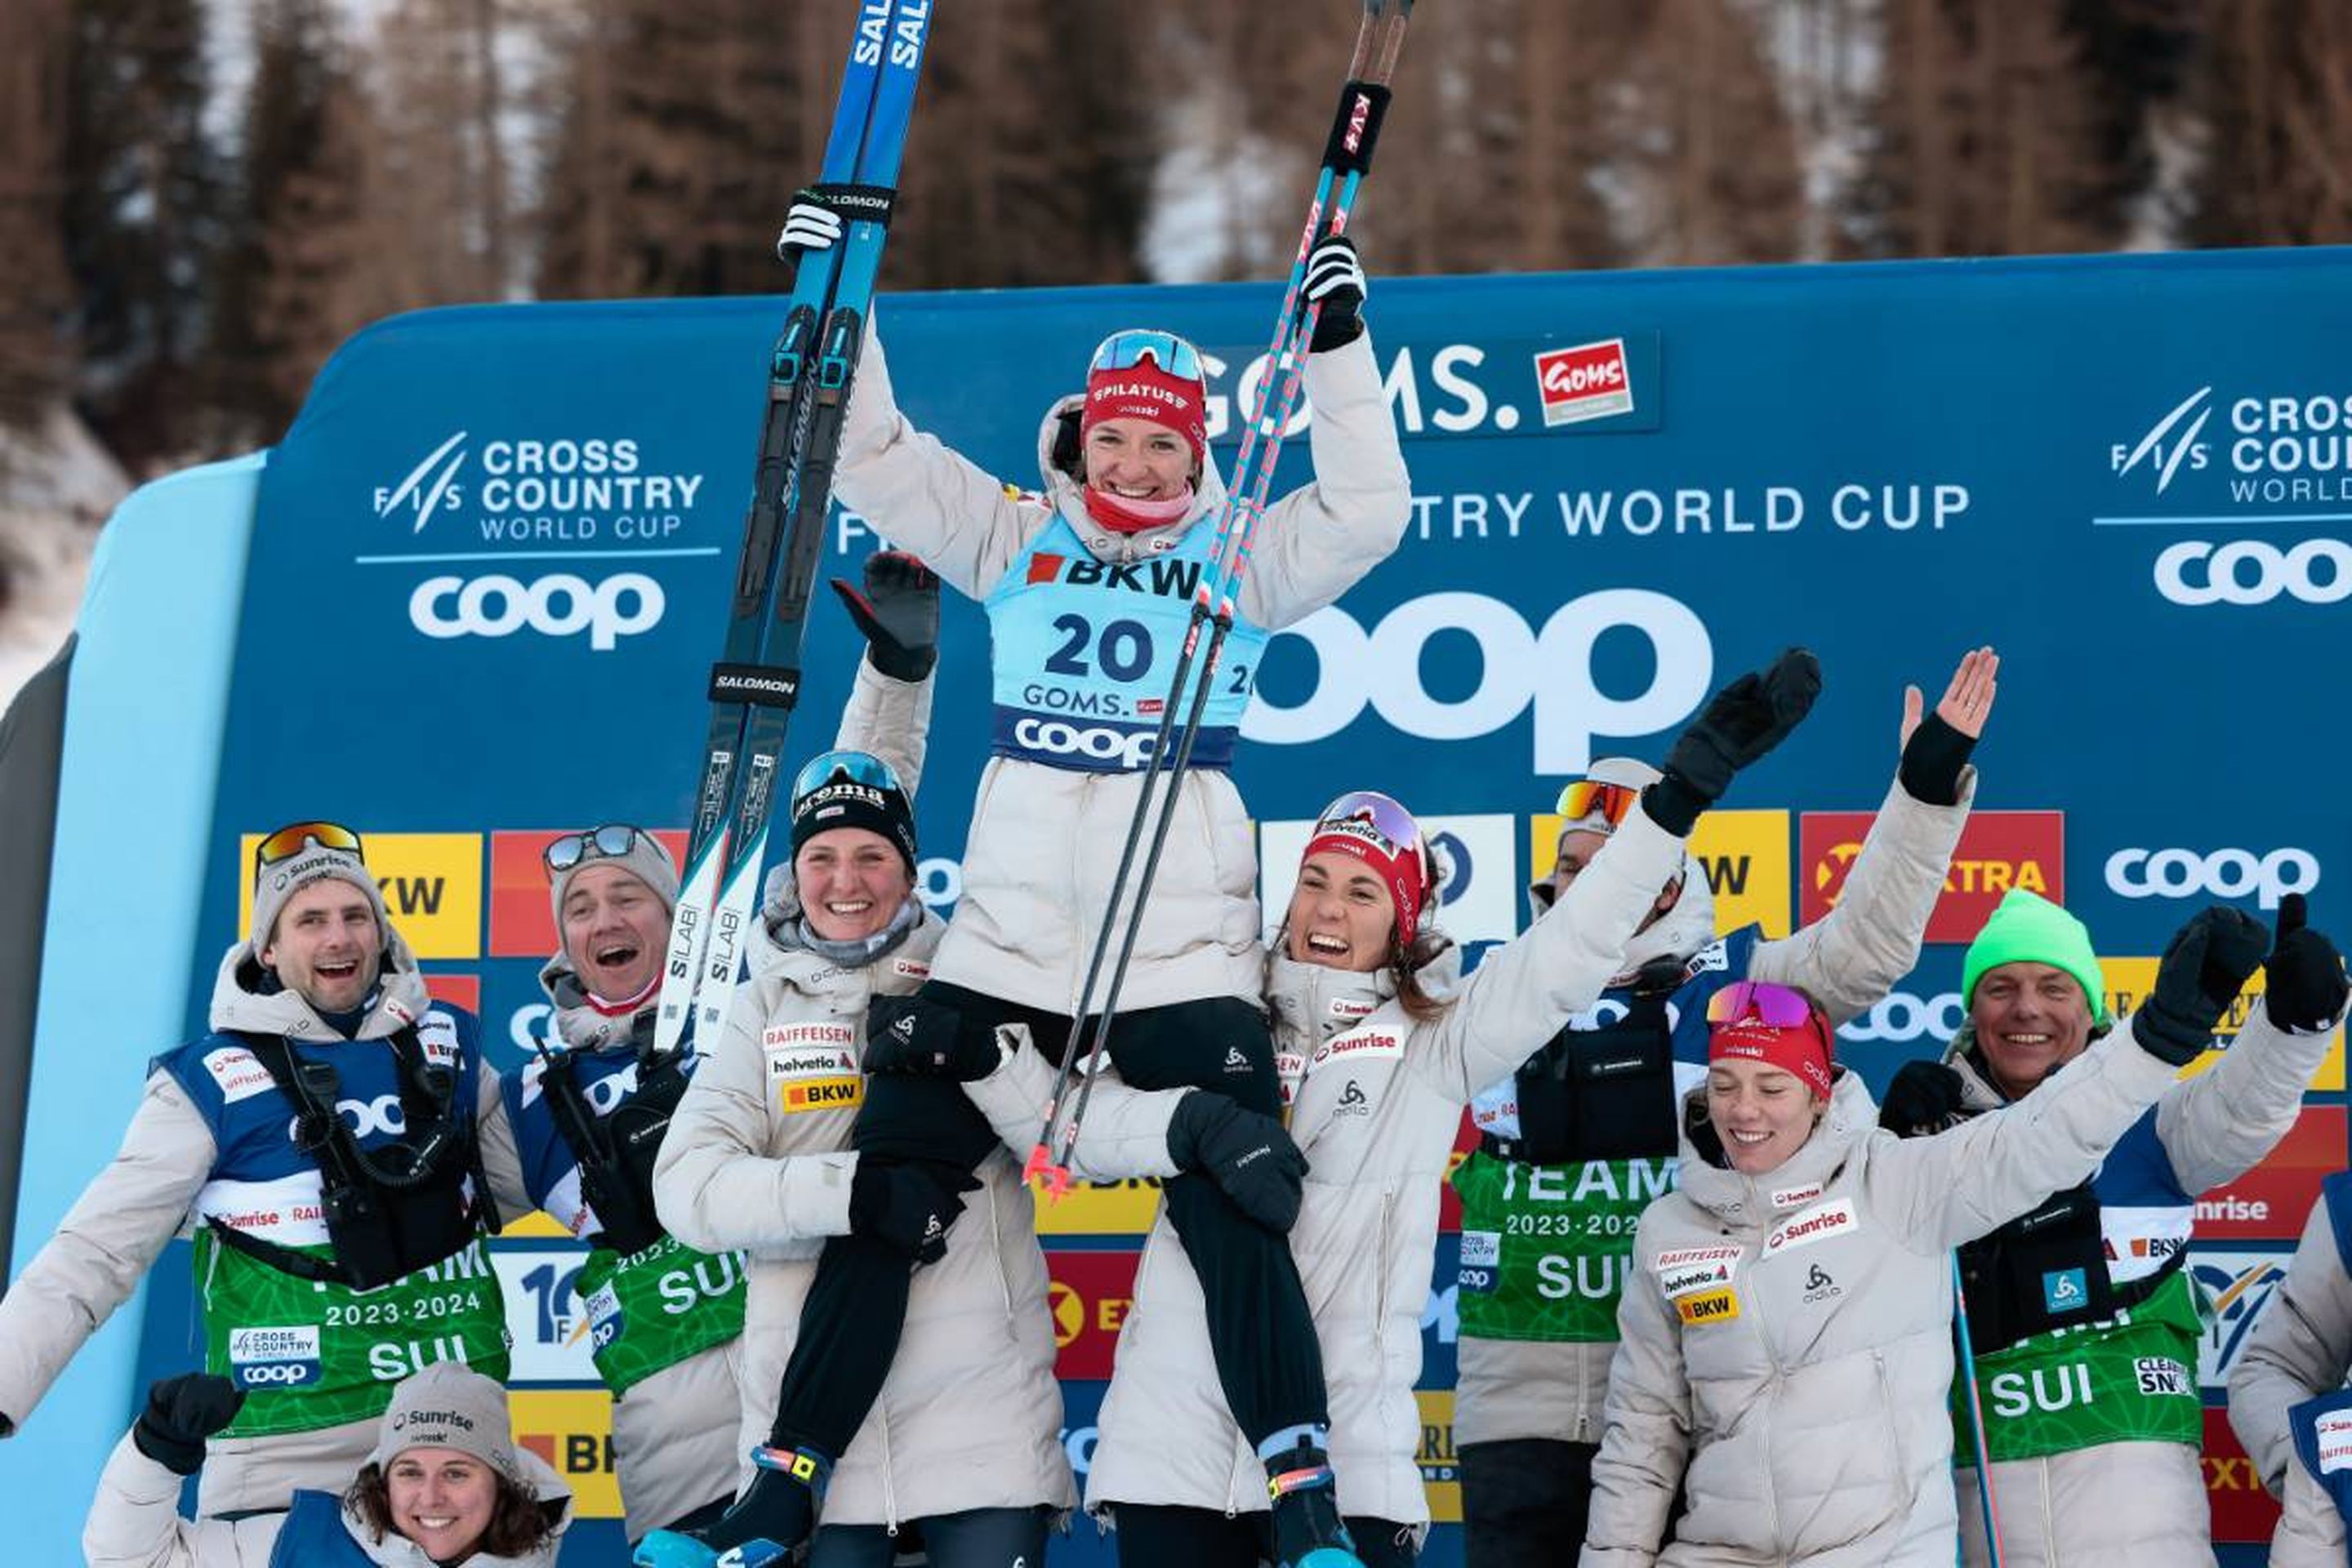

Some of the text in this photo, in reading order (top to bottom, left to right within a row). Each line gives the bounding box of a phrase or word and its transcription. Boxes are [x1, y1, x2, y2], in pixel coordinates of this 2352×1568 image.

[482, 439, 639, 474] CROSS
[482, 475, 704, 512] COUNTRY
[1557, 487, 1805, 537] WORLD
[1831, 484, 1970, 531] CUP
[480, 514, 683, 540] WORLD CUP
[1067, 559, 1201, 599] BKW
[409, 572, 666, 651] coop
[1044, 613, 1153, 683] 20
[715, 675, 795, 696] SALOMON
[1023, 684, 1129, 717] GOMS.
[765, 1027, 852, 1045] RAIFFEISEN
[1331, 1032, 1397, 1054] Sunrise
[773, 1055, 835, 1073] helvetia
[807, 1084, 855, 1102] BKW
[2194, 1198, 2270, 1221] nrise
[1784, 1211, 1847, 1241] Sunrise
[1659, 1248, 1741, 1266] RAIFFEISEN
[1664, 1272, 1713, 1294] helvetia
[1692, 1296, 1730, 1317] BKW
[253, 1341, 314, 1352] COUNTRY
[368, 1334, 467, 1381] SUI
[243, 1364, 307, 1384] coop
[1990, 1363, 2093, 1419] SUI
[408, 1410, 474, 1432] Sunrise
